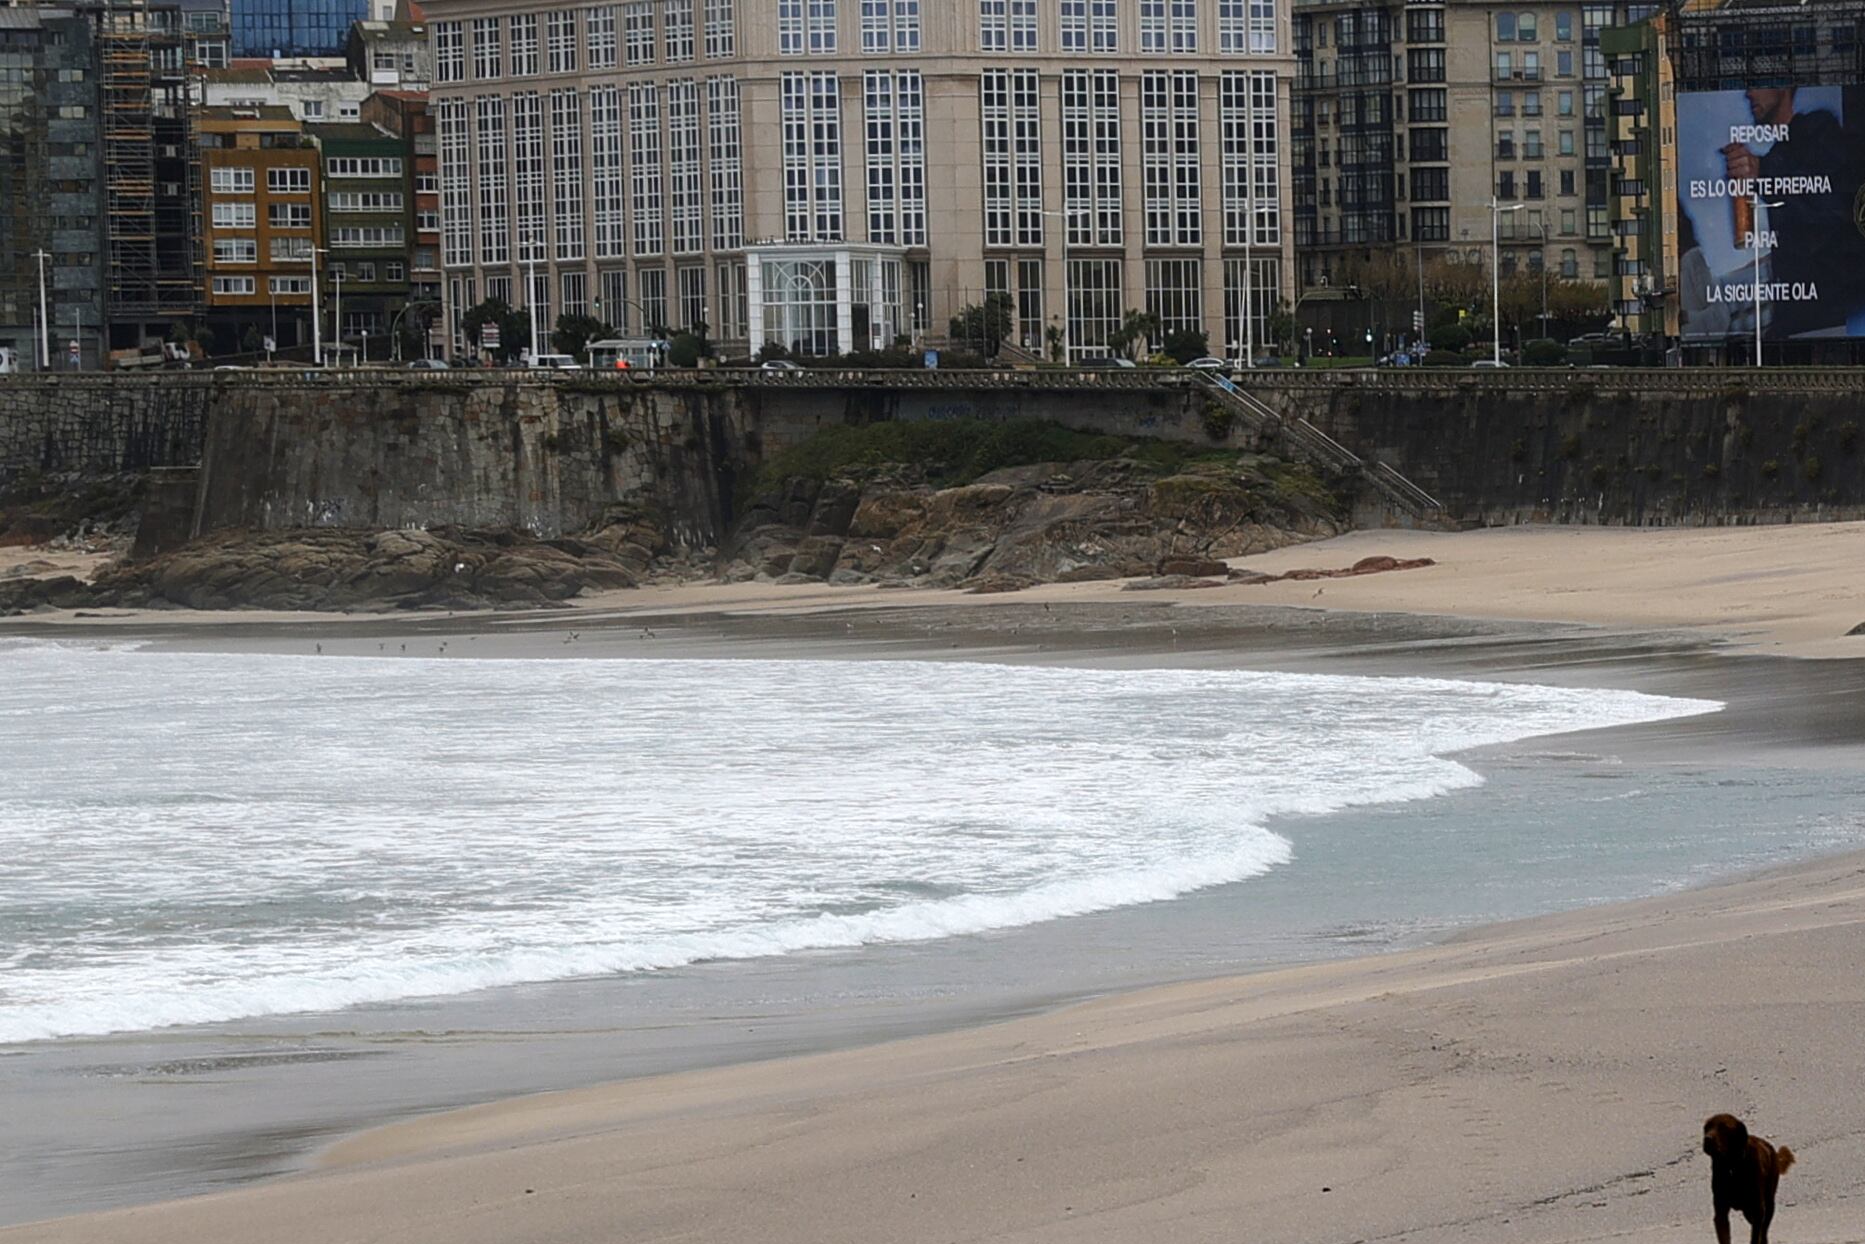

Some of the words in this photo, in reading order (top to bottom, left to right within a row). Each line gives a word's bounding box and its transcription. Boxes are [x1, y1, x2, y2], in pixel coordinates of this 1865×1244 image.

[1730, 124, 1789, 143] REPOSAR
[1690, 180, 1706, 198] ES
[1708, 179, 1725, 197] LO
[1728, 178, 1754, 196] QUE
[1757, 178, 1772, 195] TE
[1774, 175, 1832, 195] PREPARA
[1744, 230, 1778, 249] PARA
[1706, 285, 1722, 303] LA
[1724, 282, 1790, 302] SIGUIENTE
[1791, 281, 1818, 300] OLA
